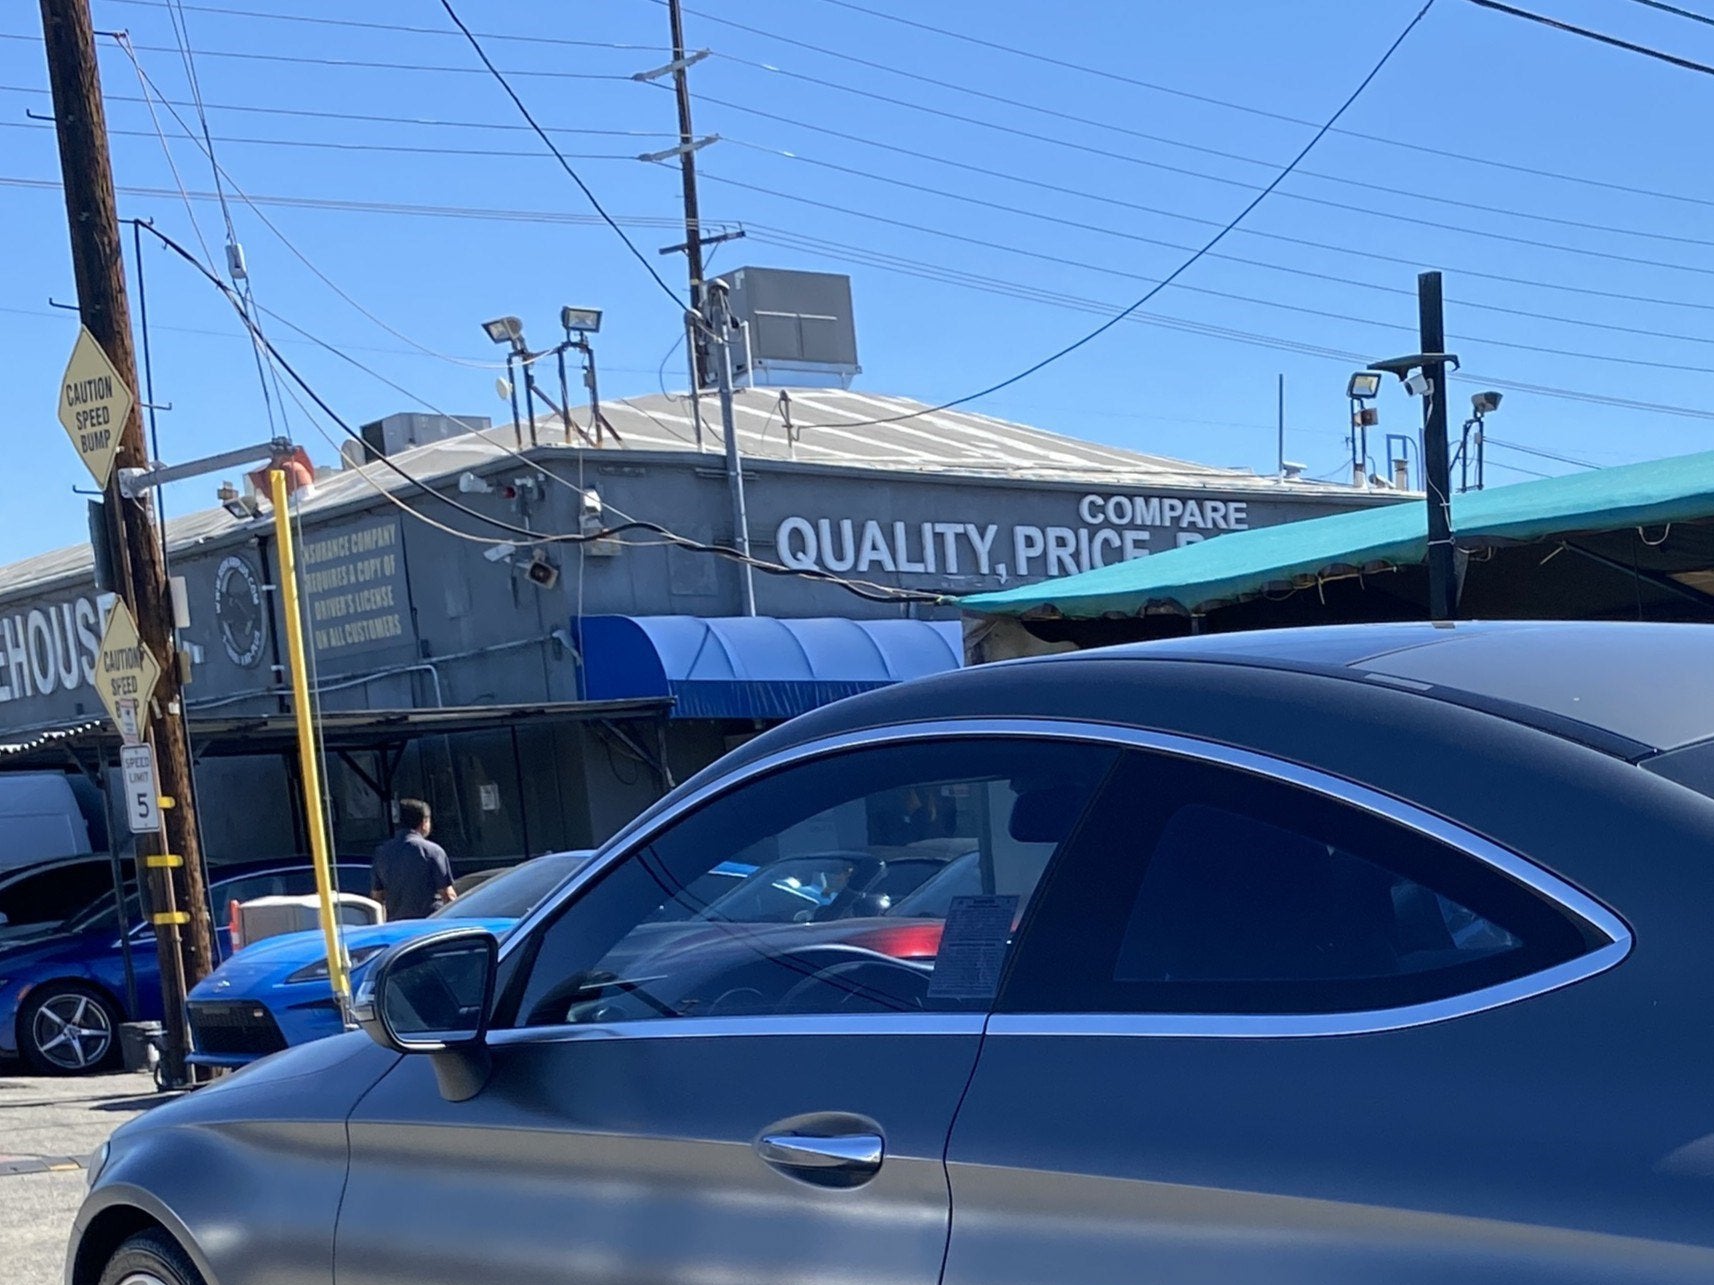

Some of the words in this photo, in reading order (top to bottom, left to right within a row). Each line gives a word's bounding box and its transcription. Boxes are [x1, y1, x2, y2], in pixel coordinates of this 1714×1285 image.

[66, 375, 113, 408] CAUTION
[75, 405, 110, 431] SPEED
[80, 429, 111, 454] BUMP
[1078, 494, 1249, 531] COMPARE
[352, 524, 395, 553] COMPANY
[775, 516, 1009, 585] QUALITY,
[350, 564, 356, 583] A
[358, 557, 381, 581] COPY
[384, 554, 394, 575] OF
[356, 585, 394, 612] LICENSE
[330, 626, 345, 647] ALL
[345, 614, 401, 644] CUSTOMERS
[103, 647, 142, 673] CAUTION
[111, 675, 138, 696] SPEED
[125, 755, 150, 769] SPEED
[128, 770, 149, 785] LIMIT
[137, 792, 150, 819] 5
